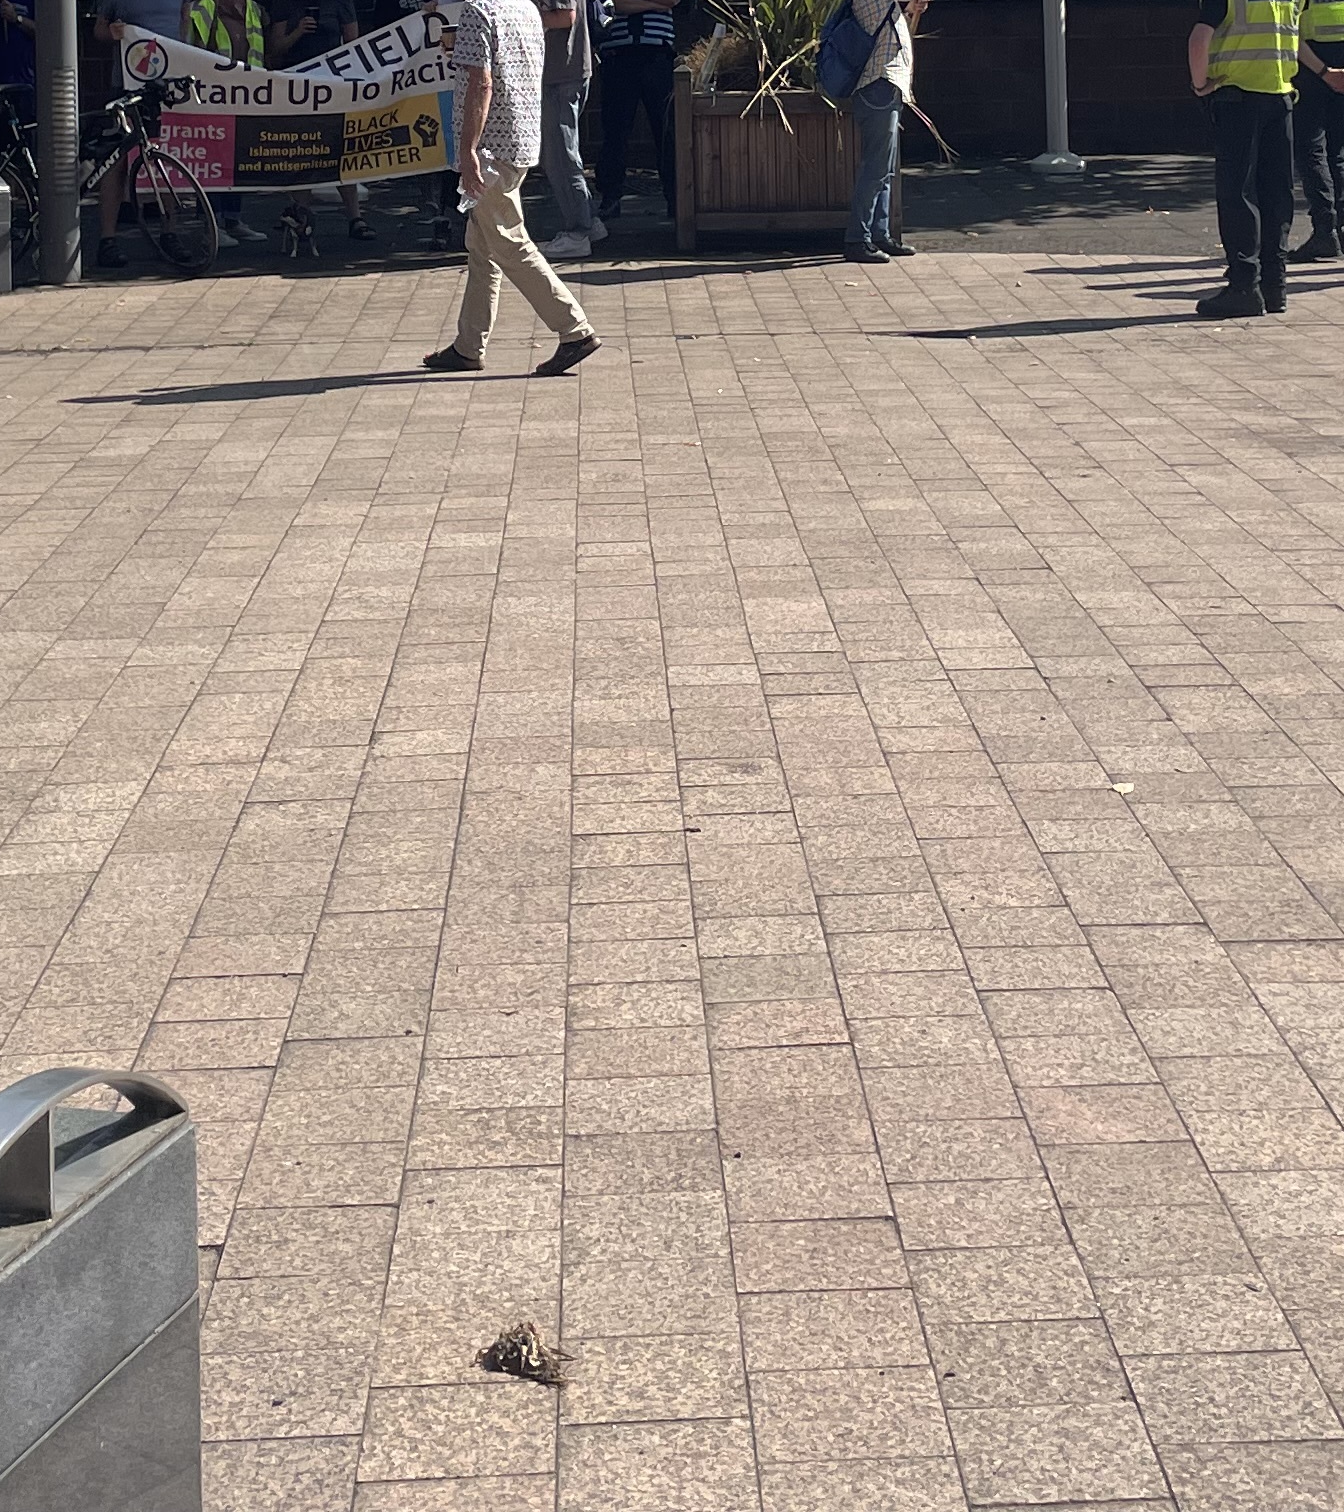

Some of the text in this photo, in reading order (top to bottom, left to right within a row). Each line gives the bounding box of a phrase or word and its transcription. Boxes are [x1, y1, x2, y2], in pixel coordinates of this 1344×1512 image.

[287, 79, 333, 112] Up
[343, 77, 381, 103] To
[345, 108, 398, 136] BLACK
[259, 130, 322, 144] Stamp out
[344, 131, 393, 154] LIVES
[249, 143, 330, 157] Islamophobia
[341, 146, 422, 173] MATTER
[86, 147, 120, 189] GIANT
[238, 157, 338, 172] and antisemitism
